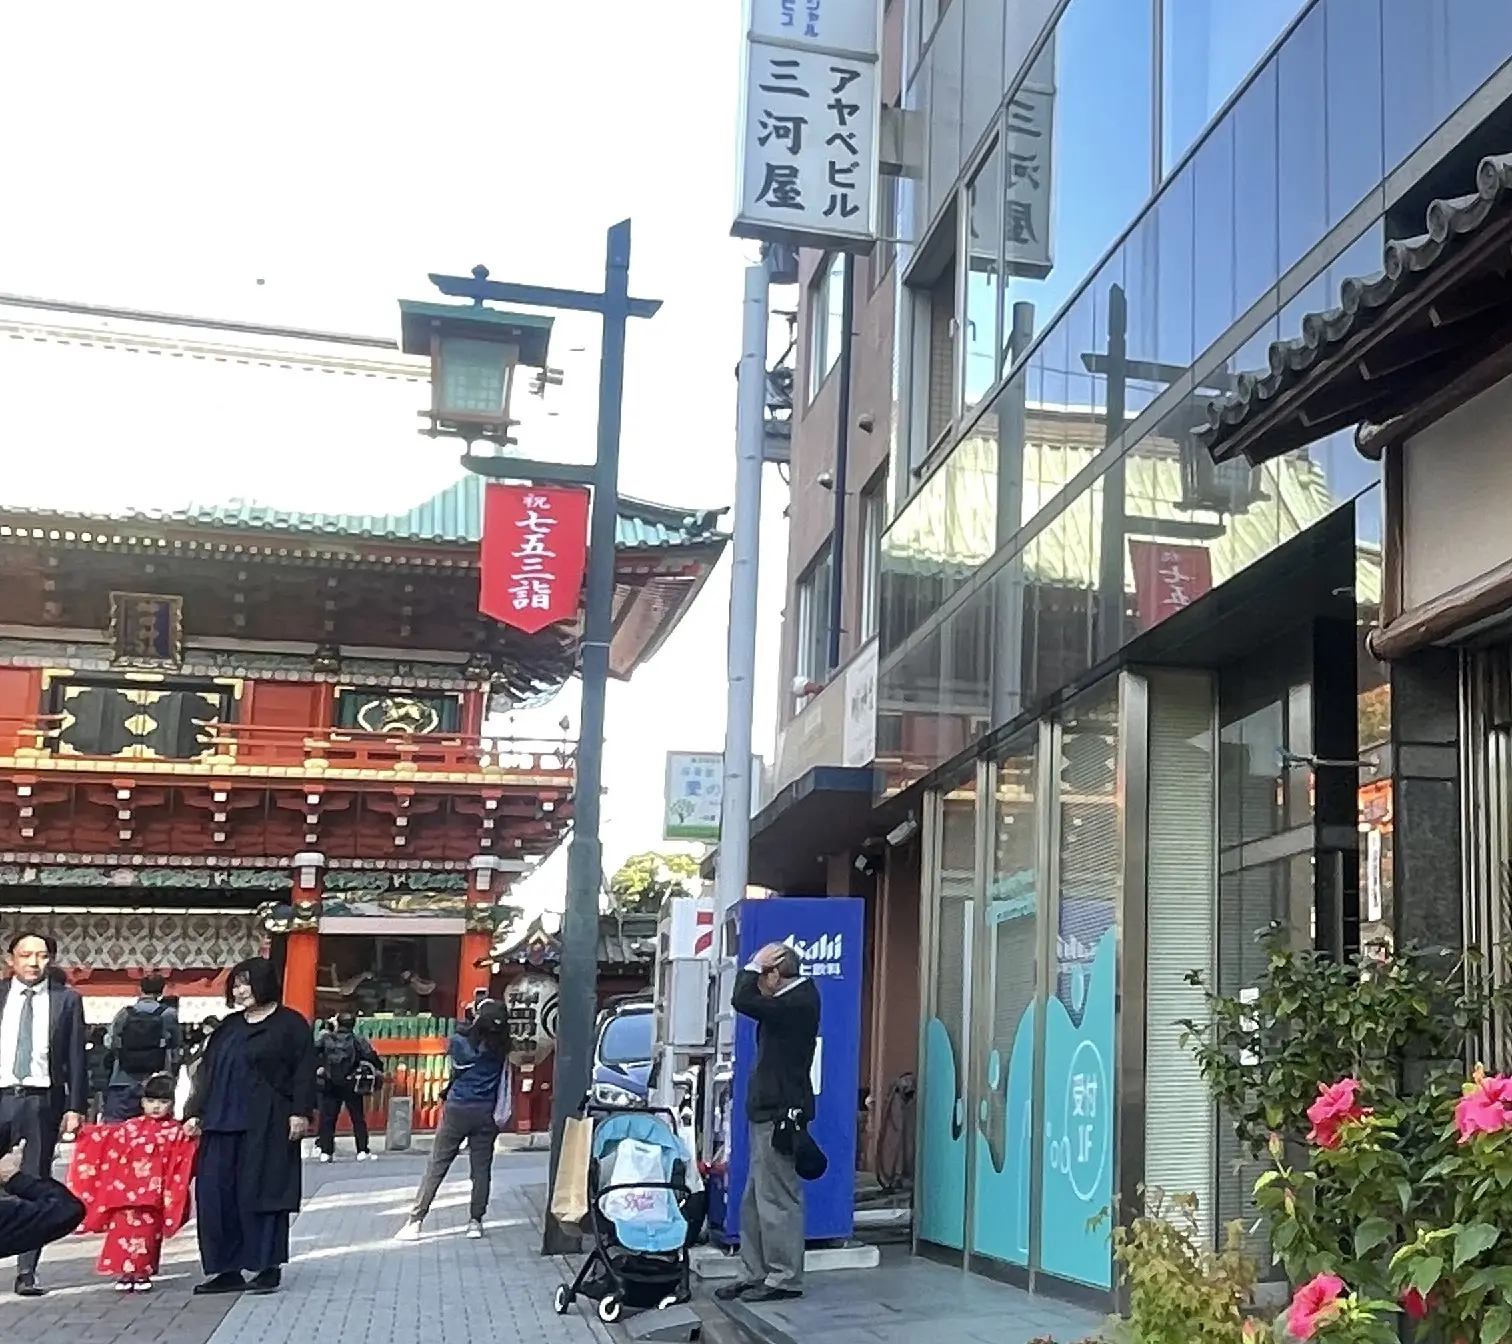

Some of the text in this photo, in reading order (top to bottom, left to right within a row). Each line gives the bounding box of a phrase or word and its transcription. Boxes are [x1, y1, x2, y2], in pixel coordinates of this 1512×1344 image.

[754, 59, 810, 211] 三河屋
[823, 66, 861, 218] アヤベビル
